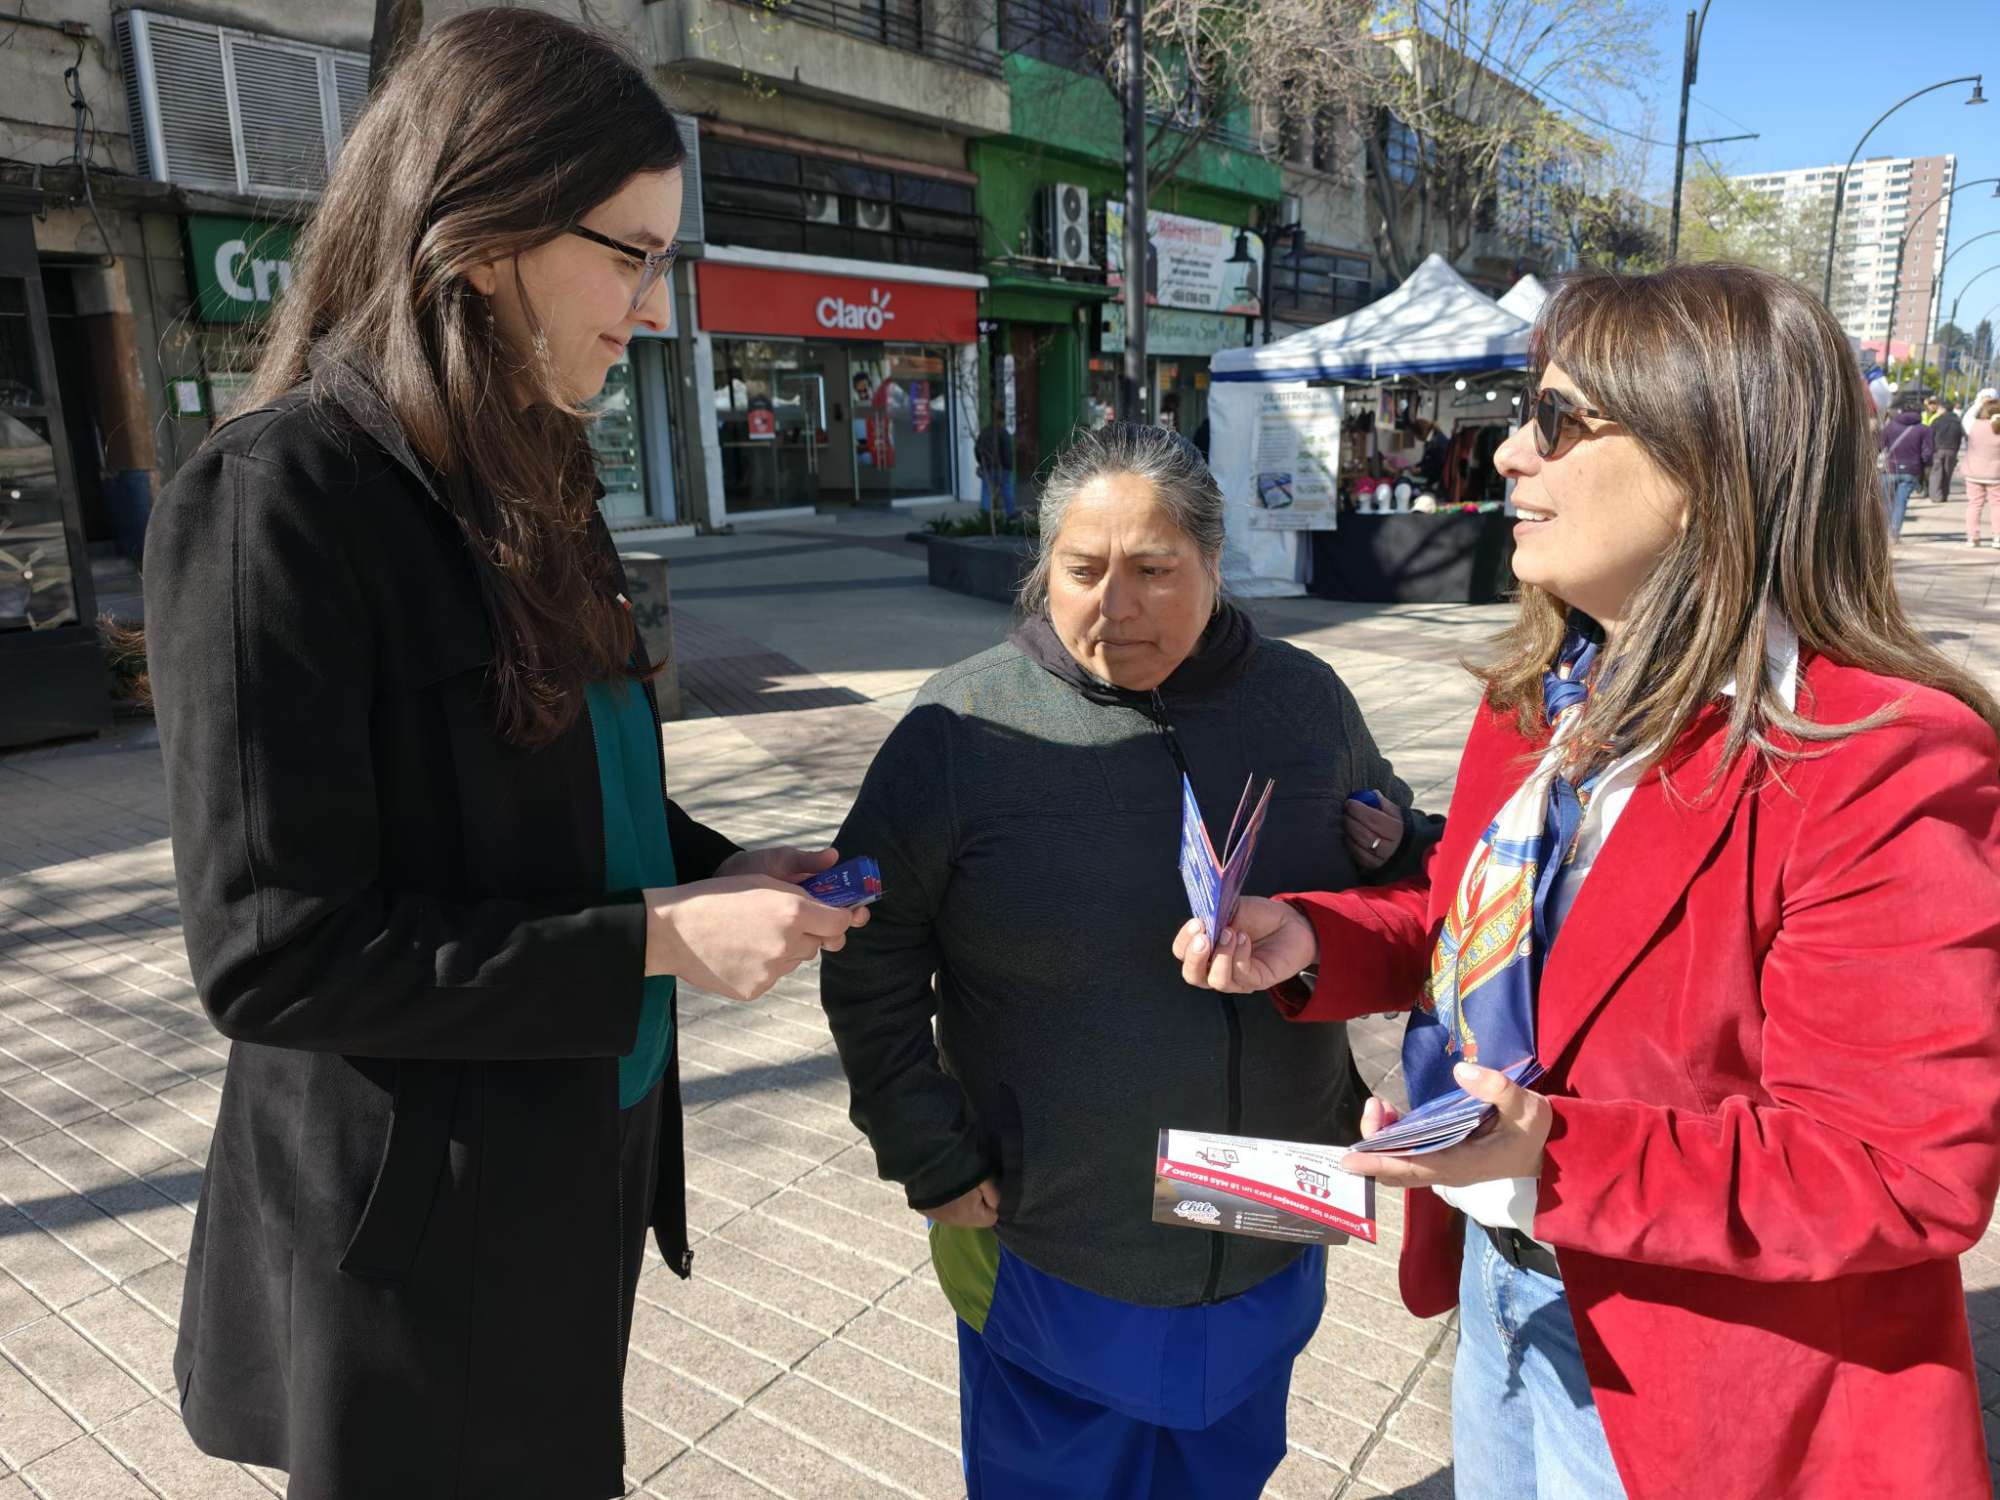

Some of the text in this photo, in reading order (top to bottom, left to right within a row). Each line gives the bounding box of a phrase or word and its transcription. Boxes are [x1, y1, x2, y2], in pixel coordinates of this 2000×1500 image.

[816, 295, 885, 331] Claro
[1171, 1167, 1208, 1183] SEGURO
[1241, 1185, 1253, 1194] un
[1254, 1189, 1272, 1200] para
[1178, 1200, 1215, 1213] Chile
[1273, 1194, 1310, 1210] consejos
[1311, 1207, 1322, 1216] los
[1322, 1212, 1361, 1231] Descubre
